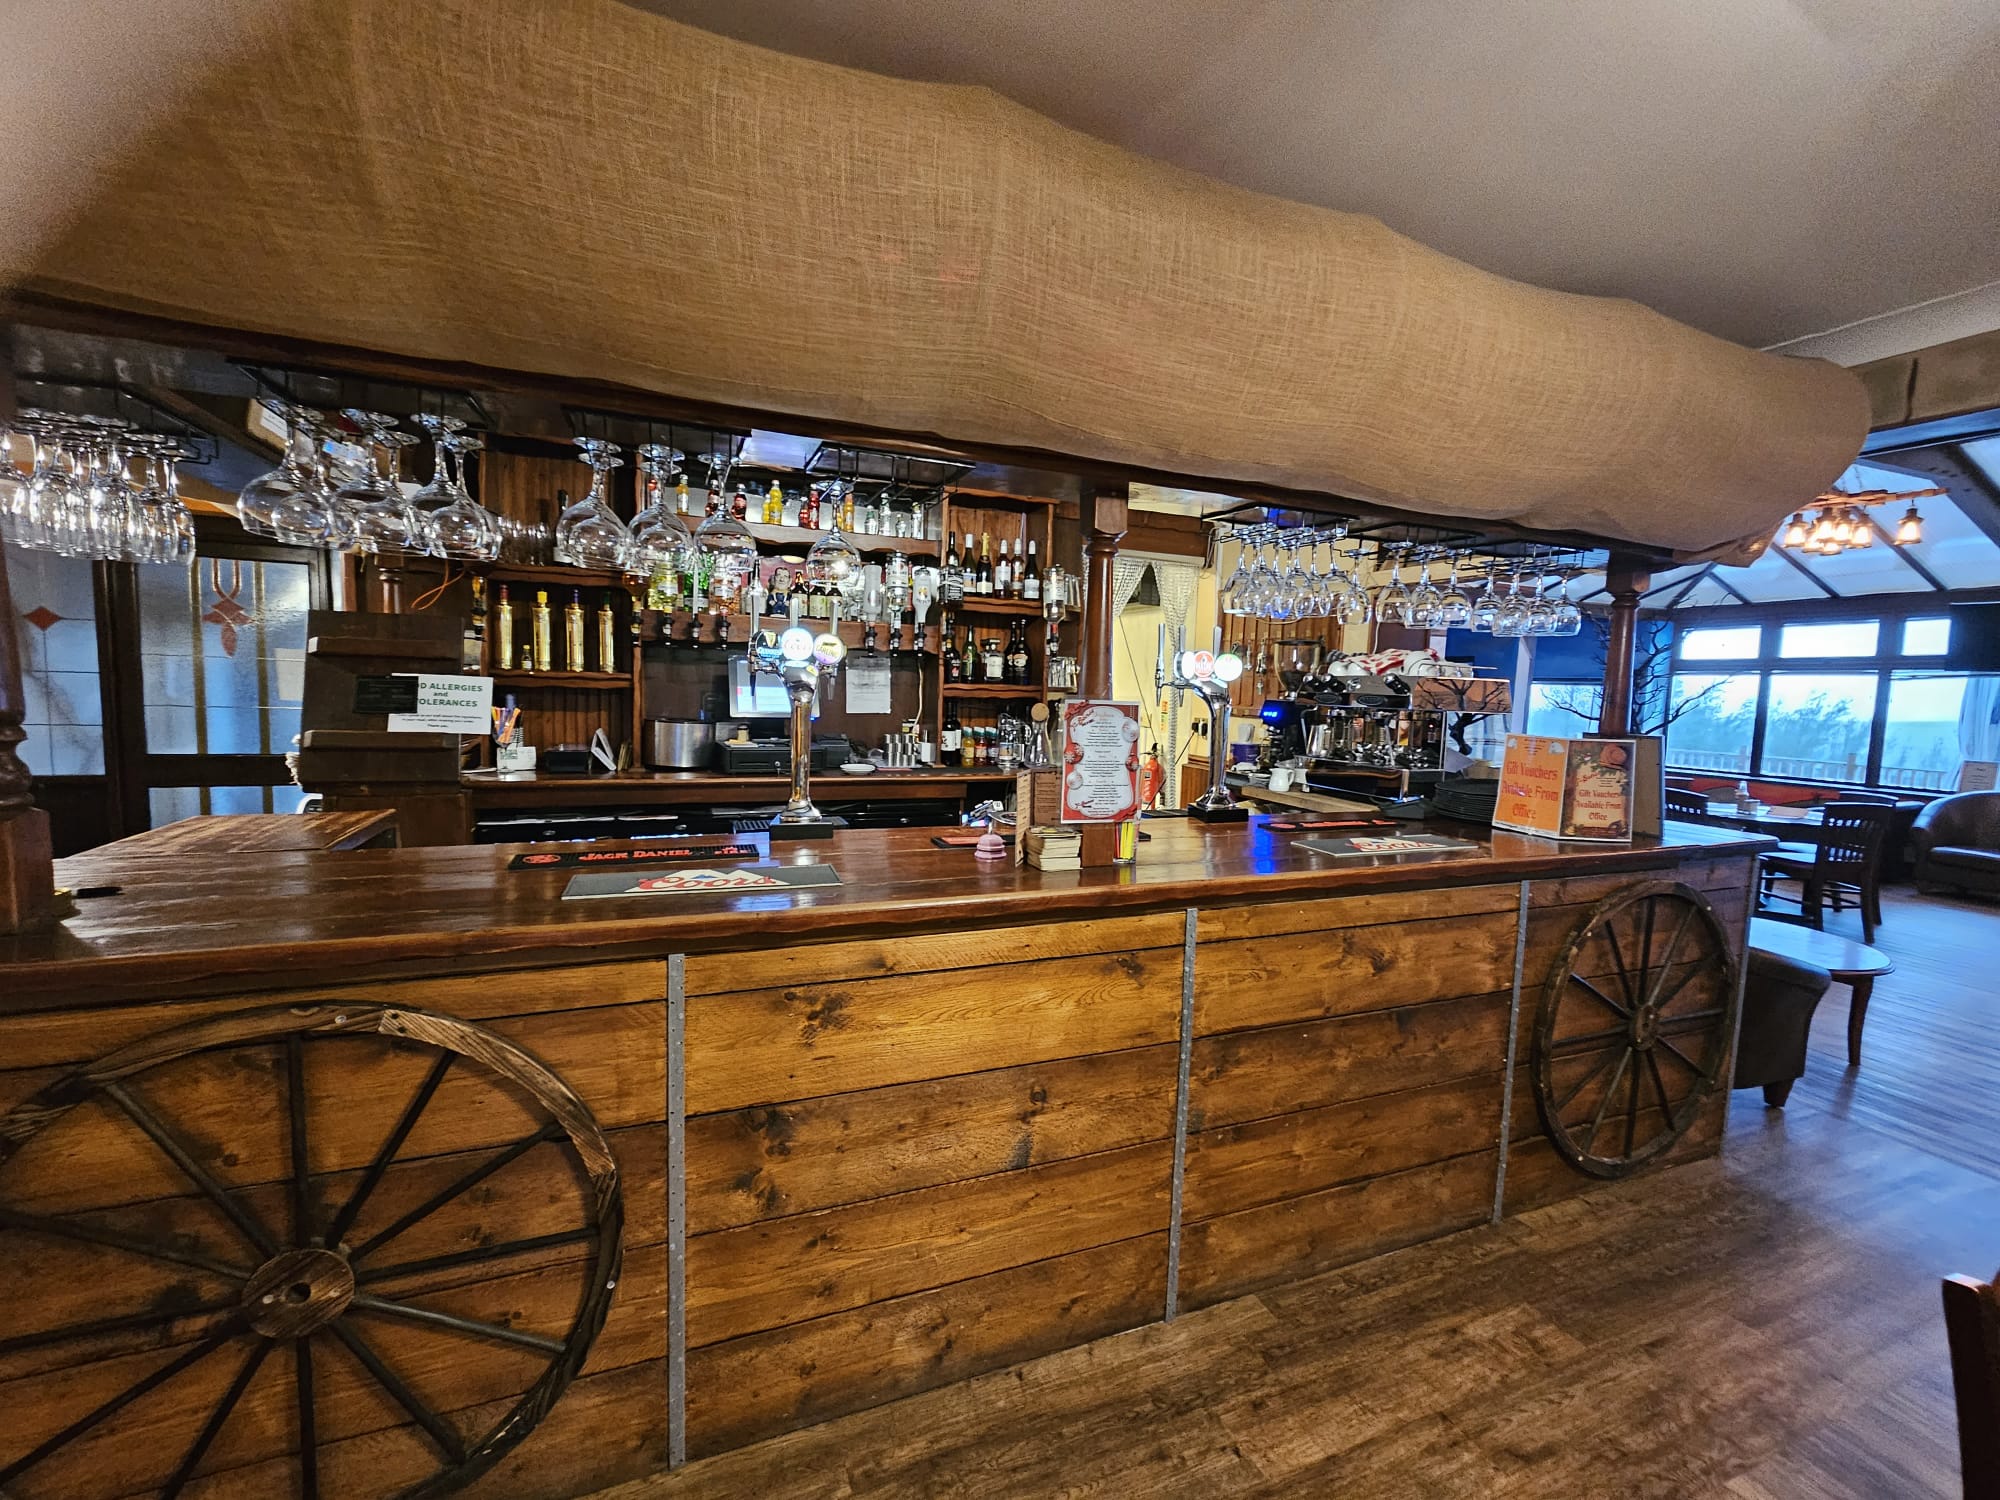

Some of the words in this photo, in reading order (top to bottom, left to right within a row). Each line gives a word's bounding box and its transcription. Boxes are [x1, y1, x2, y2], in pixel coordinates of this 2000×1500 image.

[429, 682, 483, 692] ALLERGIES
[418, 698, 478, 707] OLERANCES
[1506, 761, 1519, 775] Gift
[1520, 762, 1559, 781] Vouchers
[1535, 785, 1559, 802] From
[1512, 803, 1537, 819] Office
[1588, 812, 1608, 821] Office
[579, 851, 629, 861] JACK
[638, 875, 776, 890] Coors
